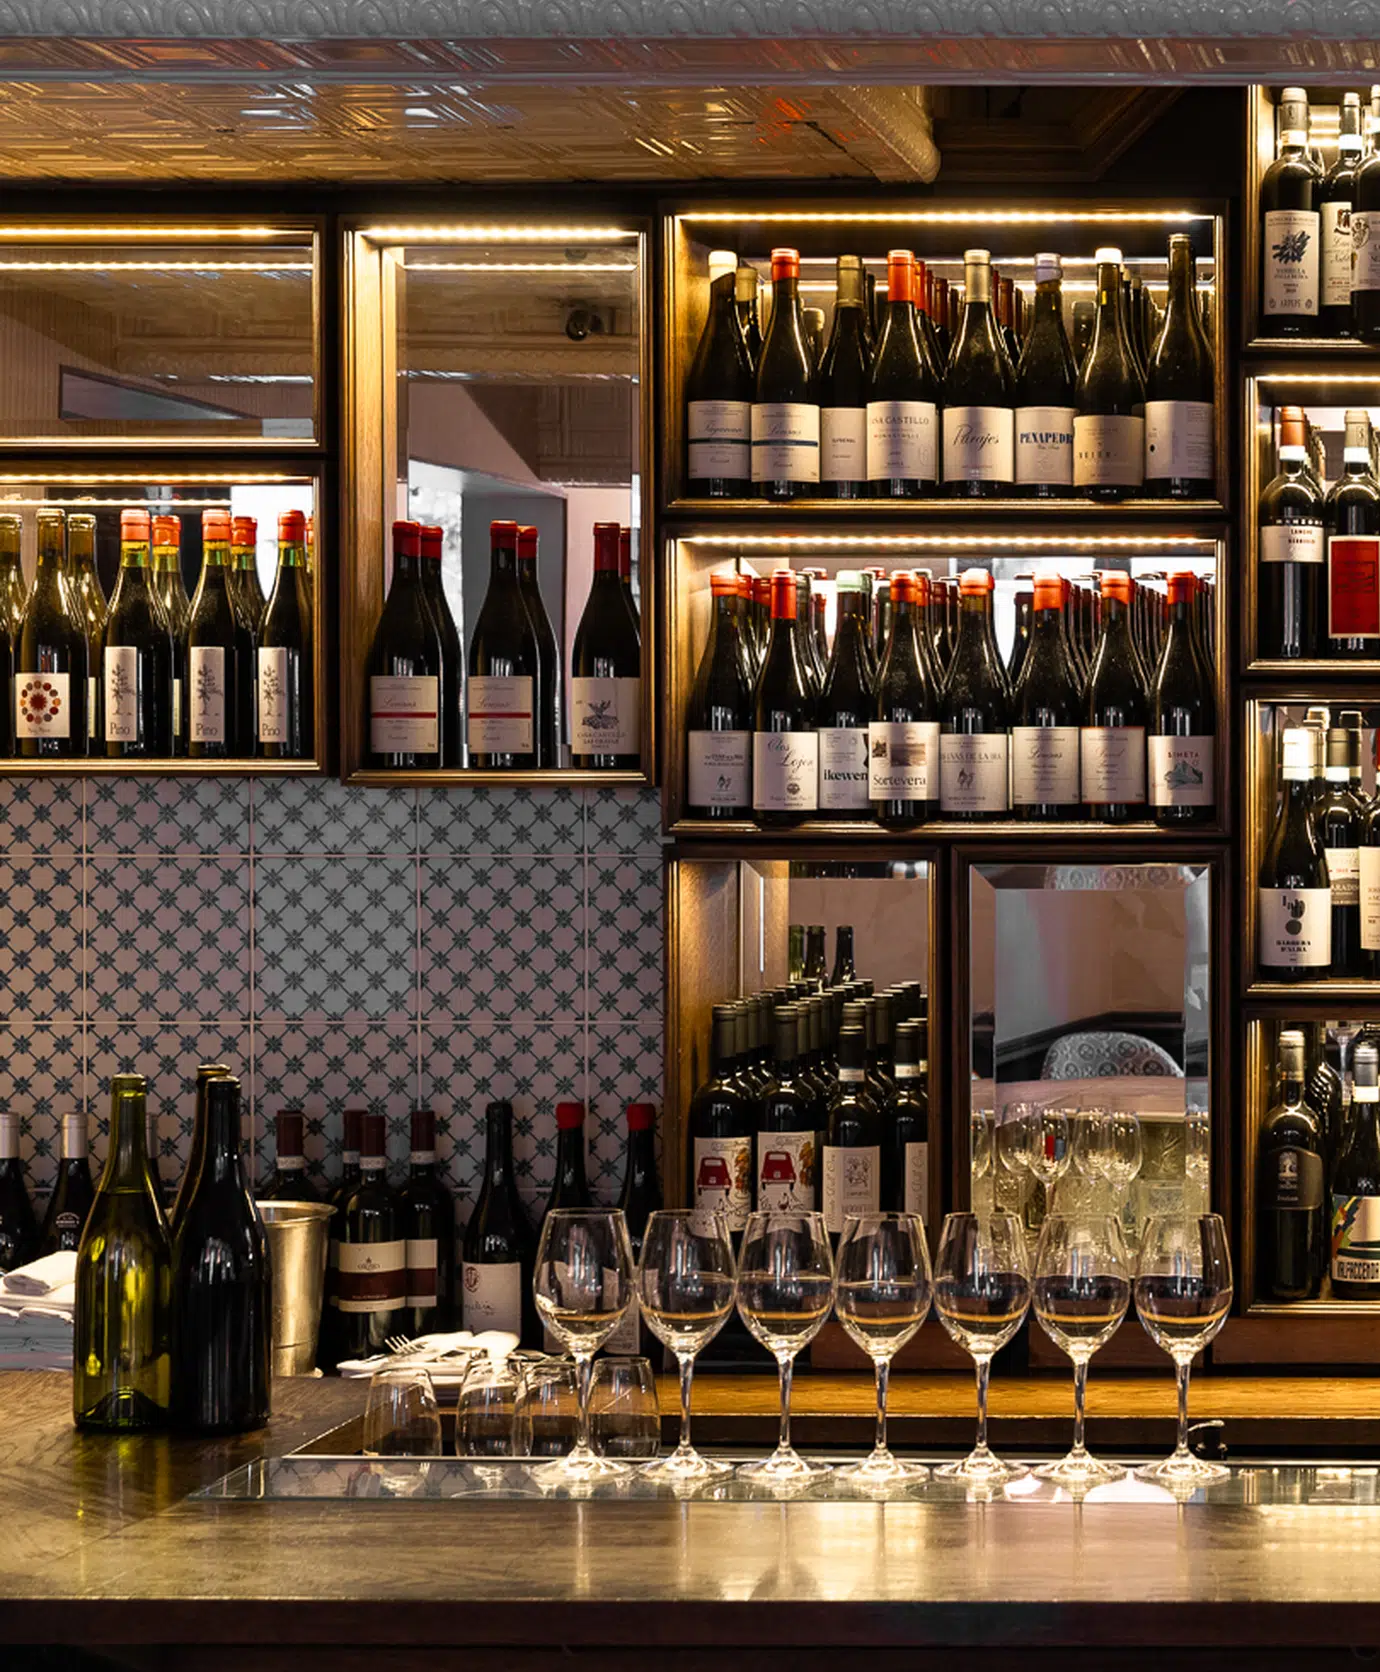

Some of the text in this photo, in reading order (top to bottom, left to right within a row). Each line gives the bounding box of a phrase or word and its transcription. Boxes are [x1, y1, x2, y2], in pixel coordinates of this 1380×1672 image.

[885, 416, 930, 425] CASTILLO
[953, 424, 1000, 451] Parajes
[110, 722, 131, 736] Pino
[196, 723, 218, 736] Pino
[262, 723, 281, 736] Pino
[873, 773, 927, 786] Sortevera
